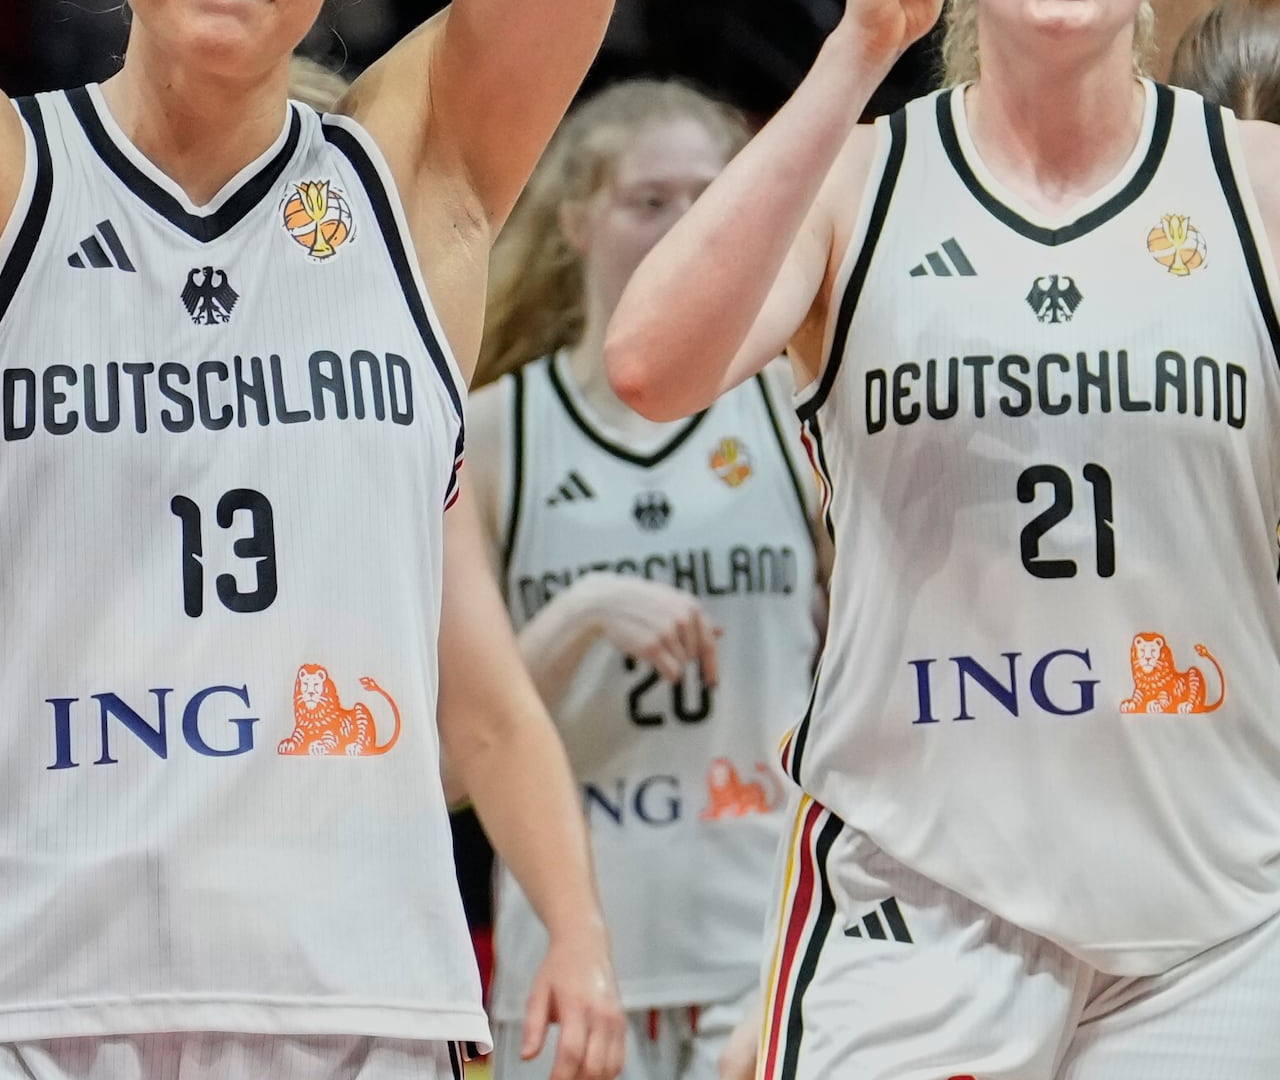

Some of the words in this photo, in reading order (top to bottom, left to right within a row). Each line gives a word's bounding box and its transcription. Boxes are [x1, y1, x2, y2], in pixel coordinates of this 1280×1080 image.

[2, 349, 415, 442] DEUTSCHLAND
[865, 350, 1247, 435] DEUTSCHLAND
[170, 488, 279, 619] 13
[1016, 462, 1116, 580] 21
[44, 684, 261, 772] ING
[907, 647, 1102, 726] ING
[583, 774, 681, 828] NG
